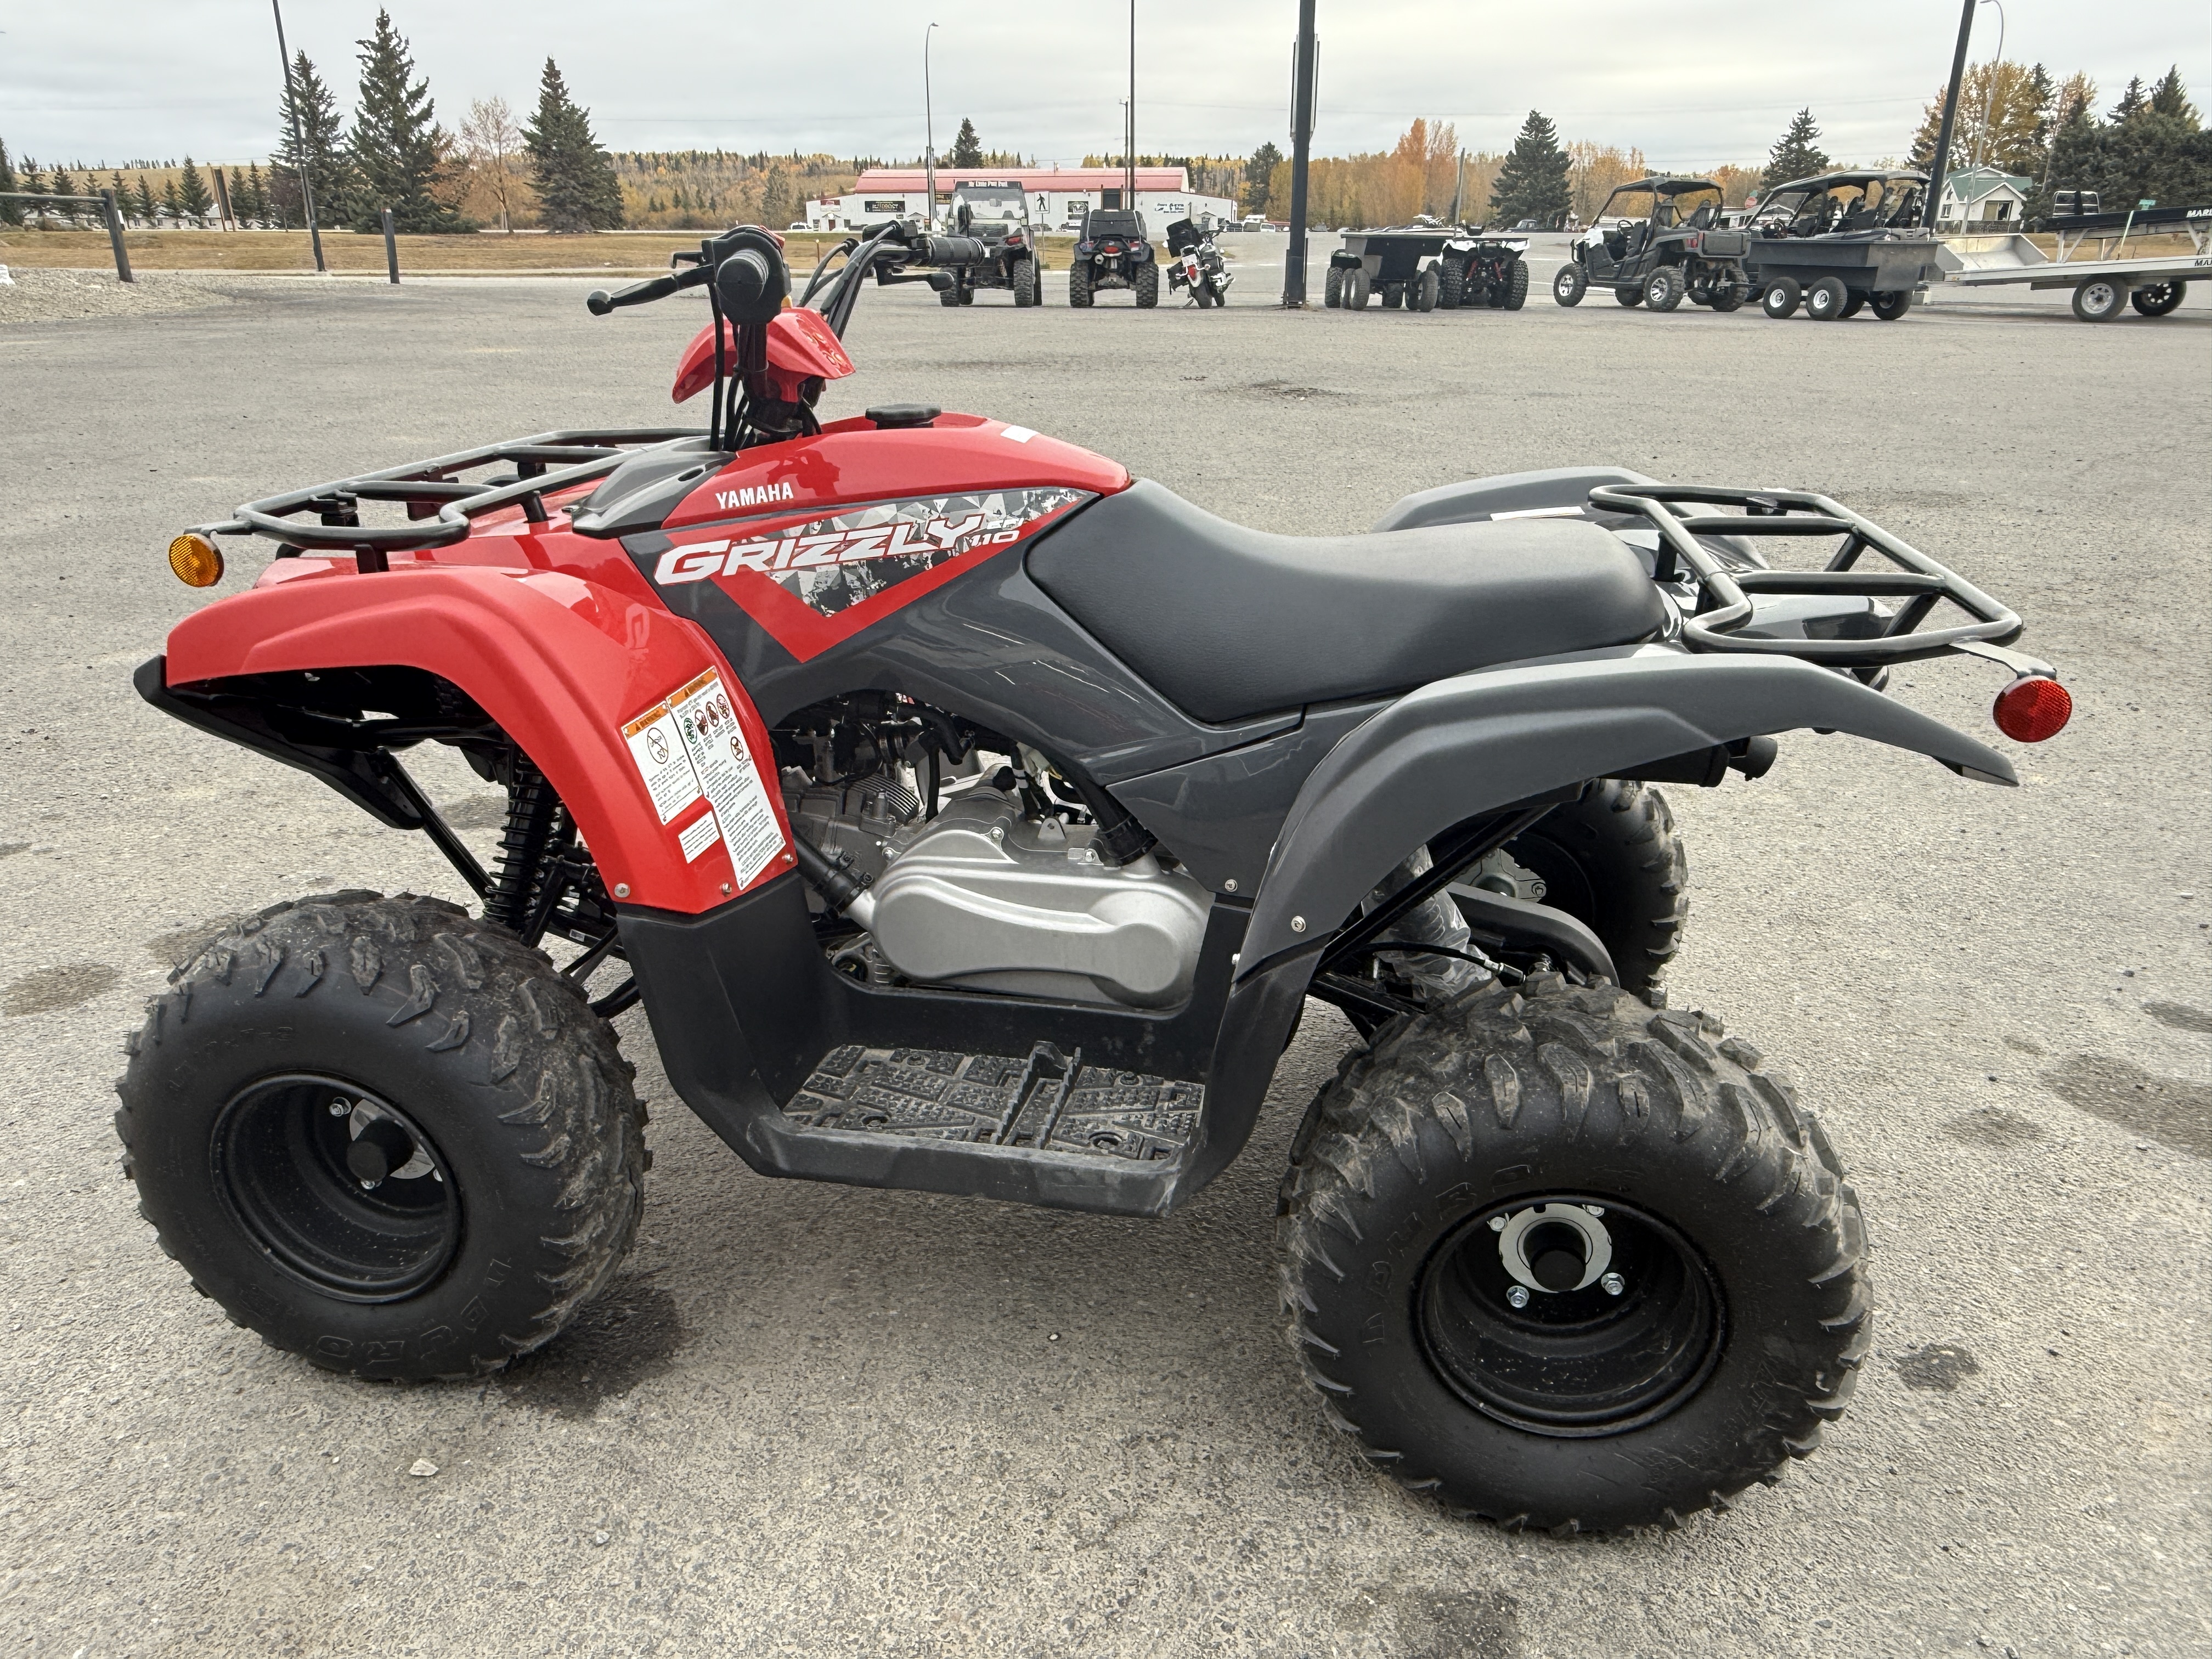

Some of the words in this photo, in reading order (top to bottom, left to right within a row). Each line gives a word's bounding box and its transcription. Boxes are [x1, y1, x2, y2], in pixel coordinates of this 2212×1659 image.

[715, 482, 794, 510] YAMAHA
[653, 515, 983, 585] GRIZZLY
[969, 530, 1020, 547] 110
